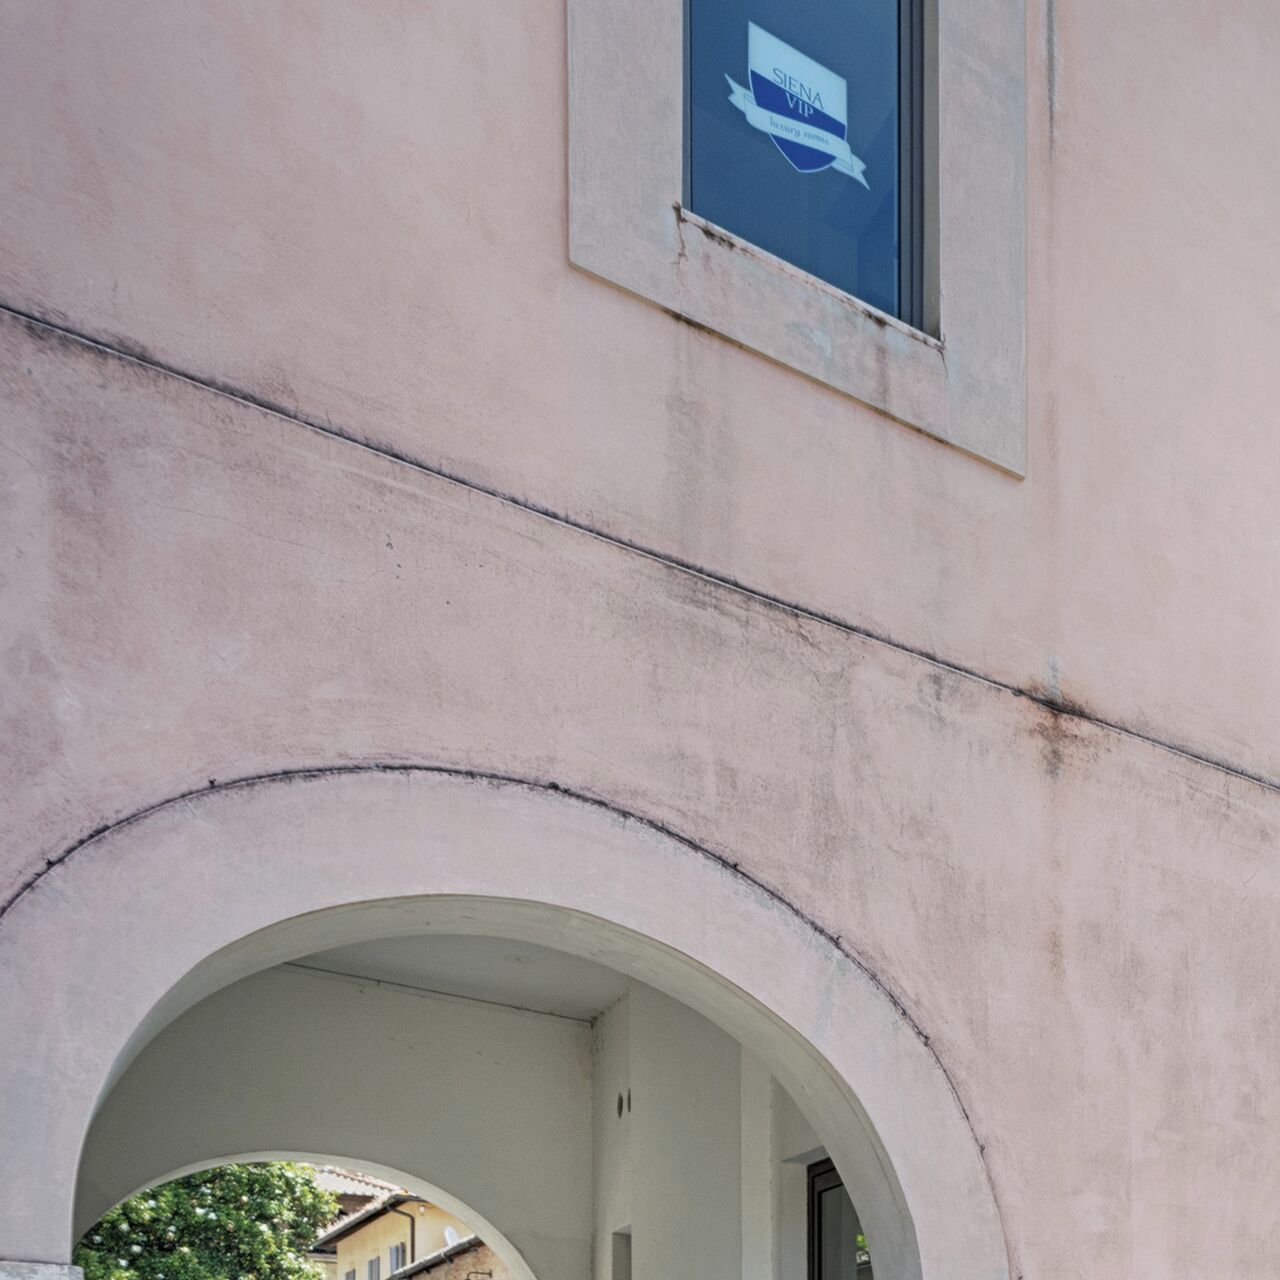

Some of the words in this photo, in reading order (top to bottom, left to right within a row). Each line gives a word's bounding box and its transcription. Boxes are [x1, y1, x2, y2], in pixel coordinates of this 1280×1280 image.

[773, 67, 824, 110] SIENA
[785, 92, 814, 118] VIP
[769, 116, 801, 137] luxury
